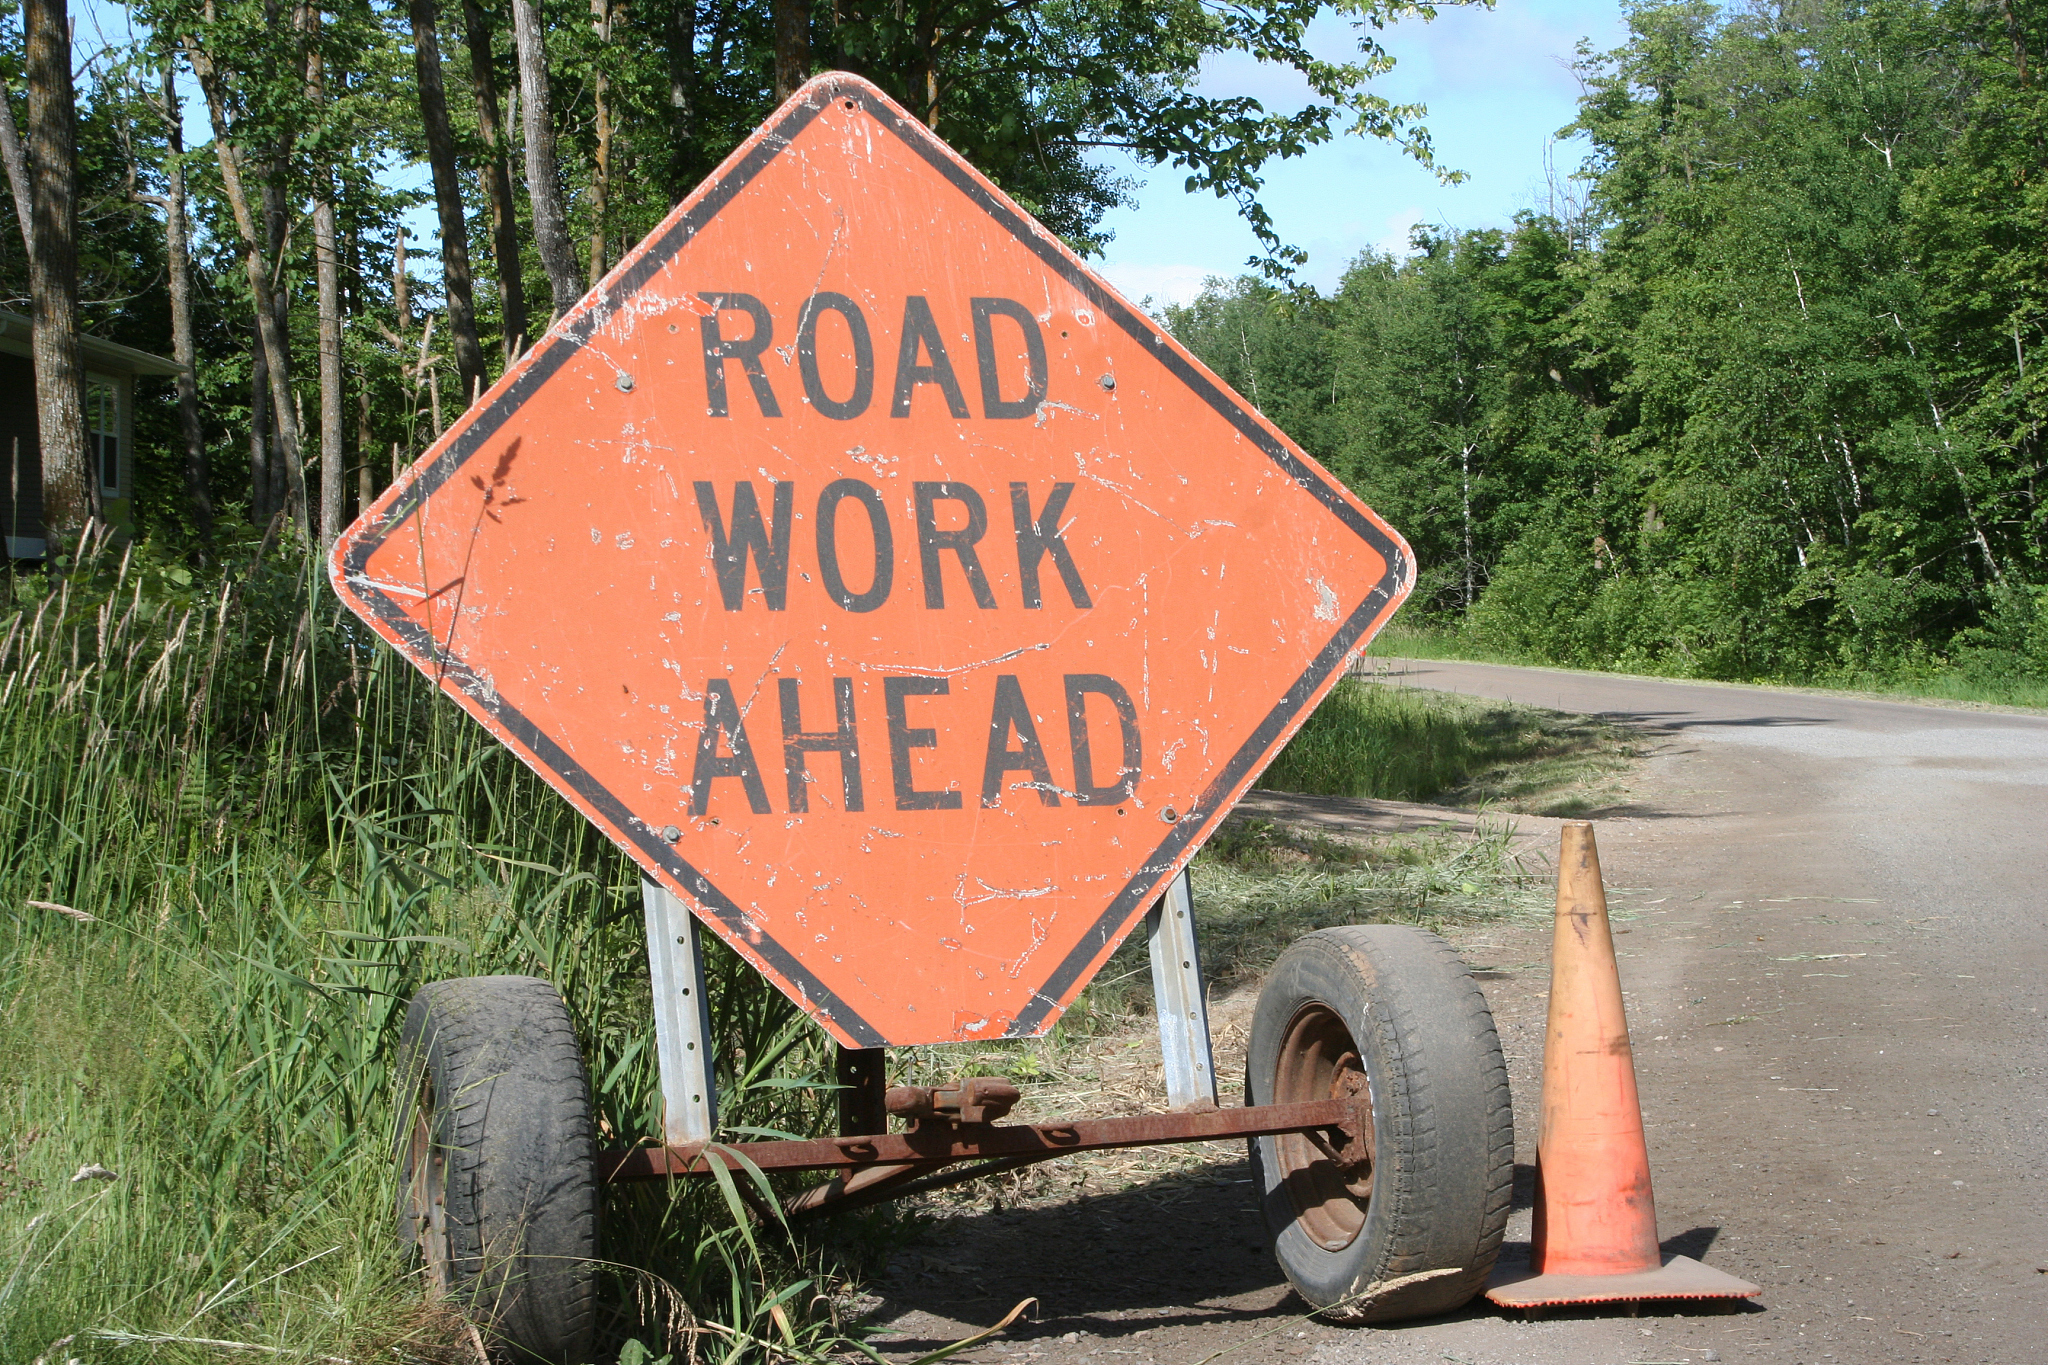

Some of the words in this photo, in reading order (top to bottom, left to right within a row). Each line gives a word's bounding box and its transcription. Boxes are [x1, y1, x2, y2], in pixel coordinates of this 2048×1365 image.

[698, 291, 1048, 420] ROAD
[693, 479, 1093, 613] WORK
[687, 674, 1142, 816] AHEAD
